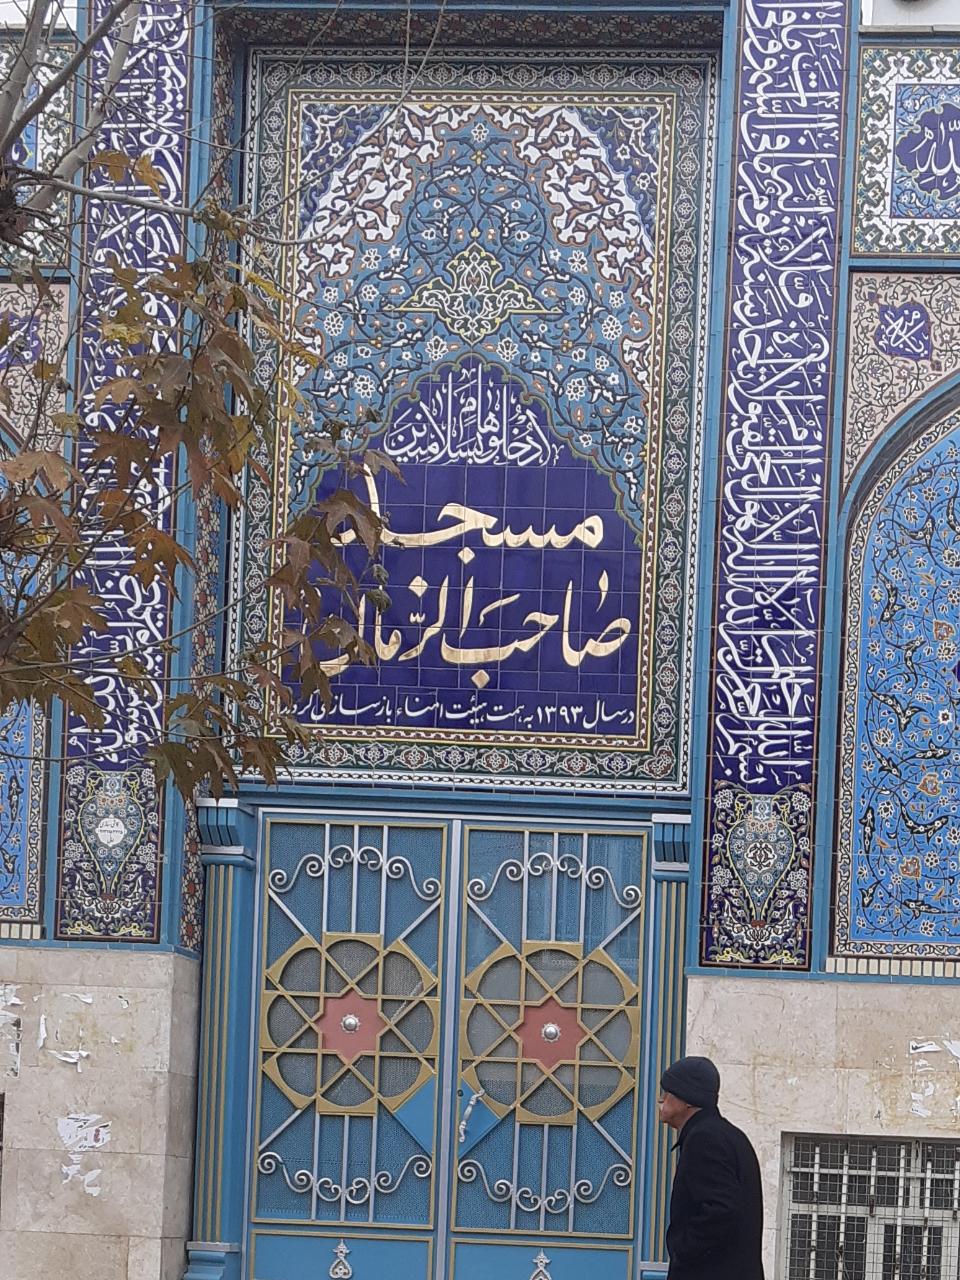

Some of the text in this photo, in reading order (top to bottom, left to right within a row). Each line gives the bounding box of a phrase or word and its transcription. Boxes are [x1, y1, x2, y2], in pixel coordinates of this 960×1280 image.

[331, 464, 604, 564] مسجد
[440, 570, 632, 689] صاحب
[536, 705, 583, 724] ۱۳۹۳
